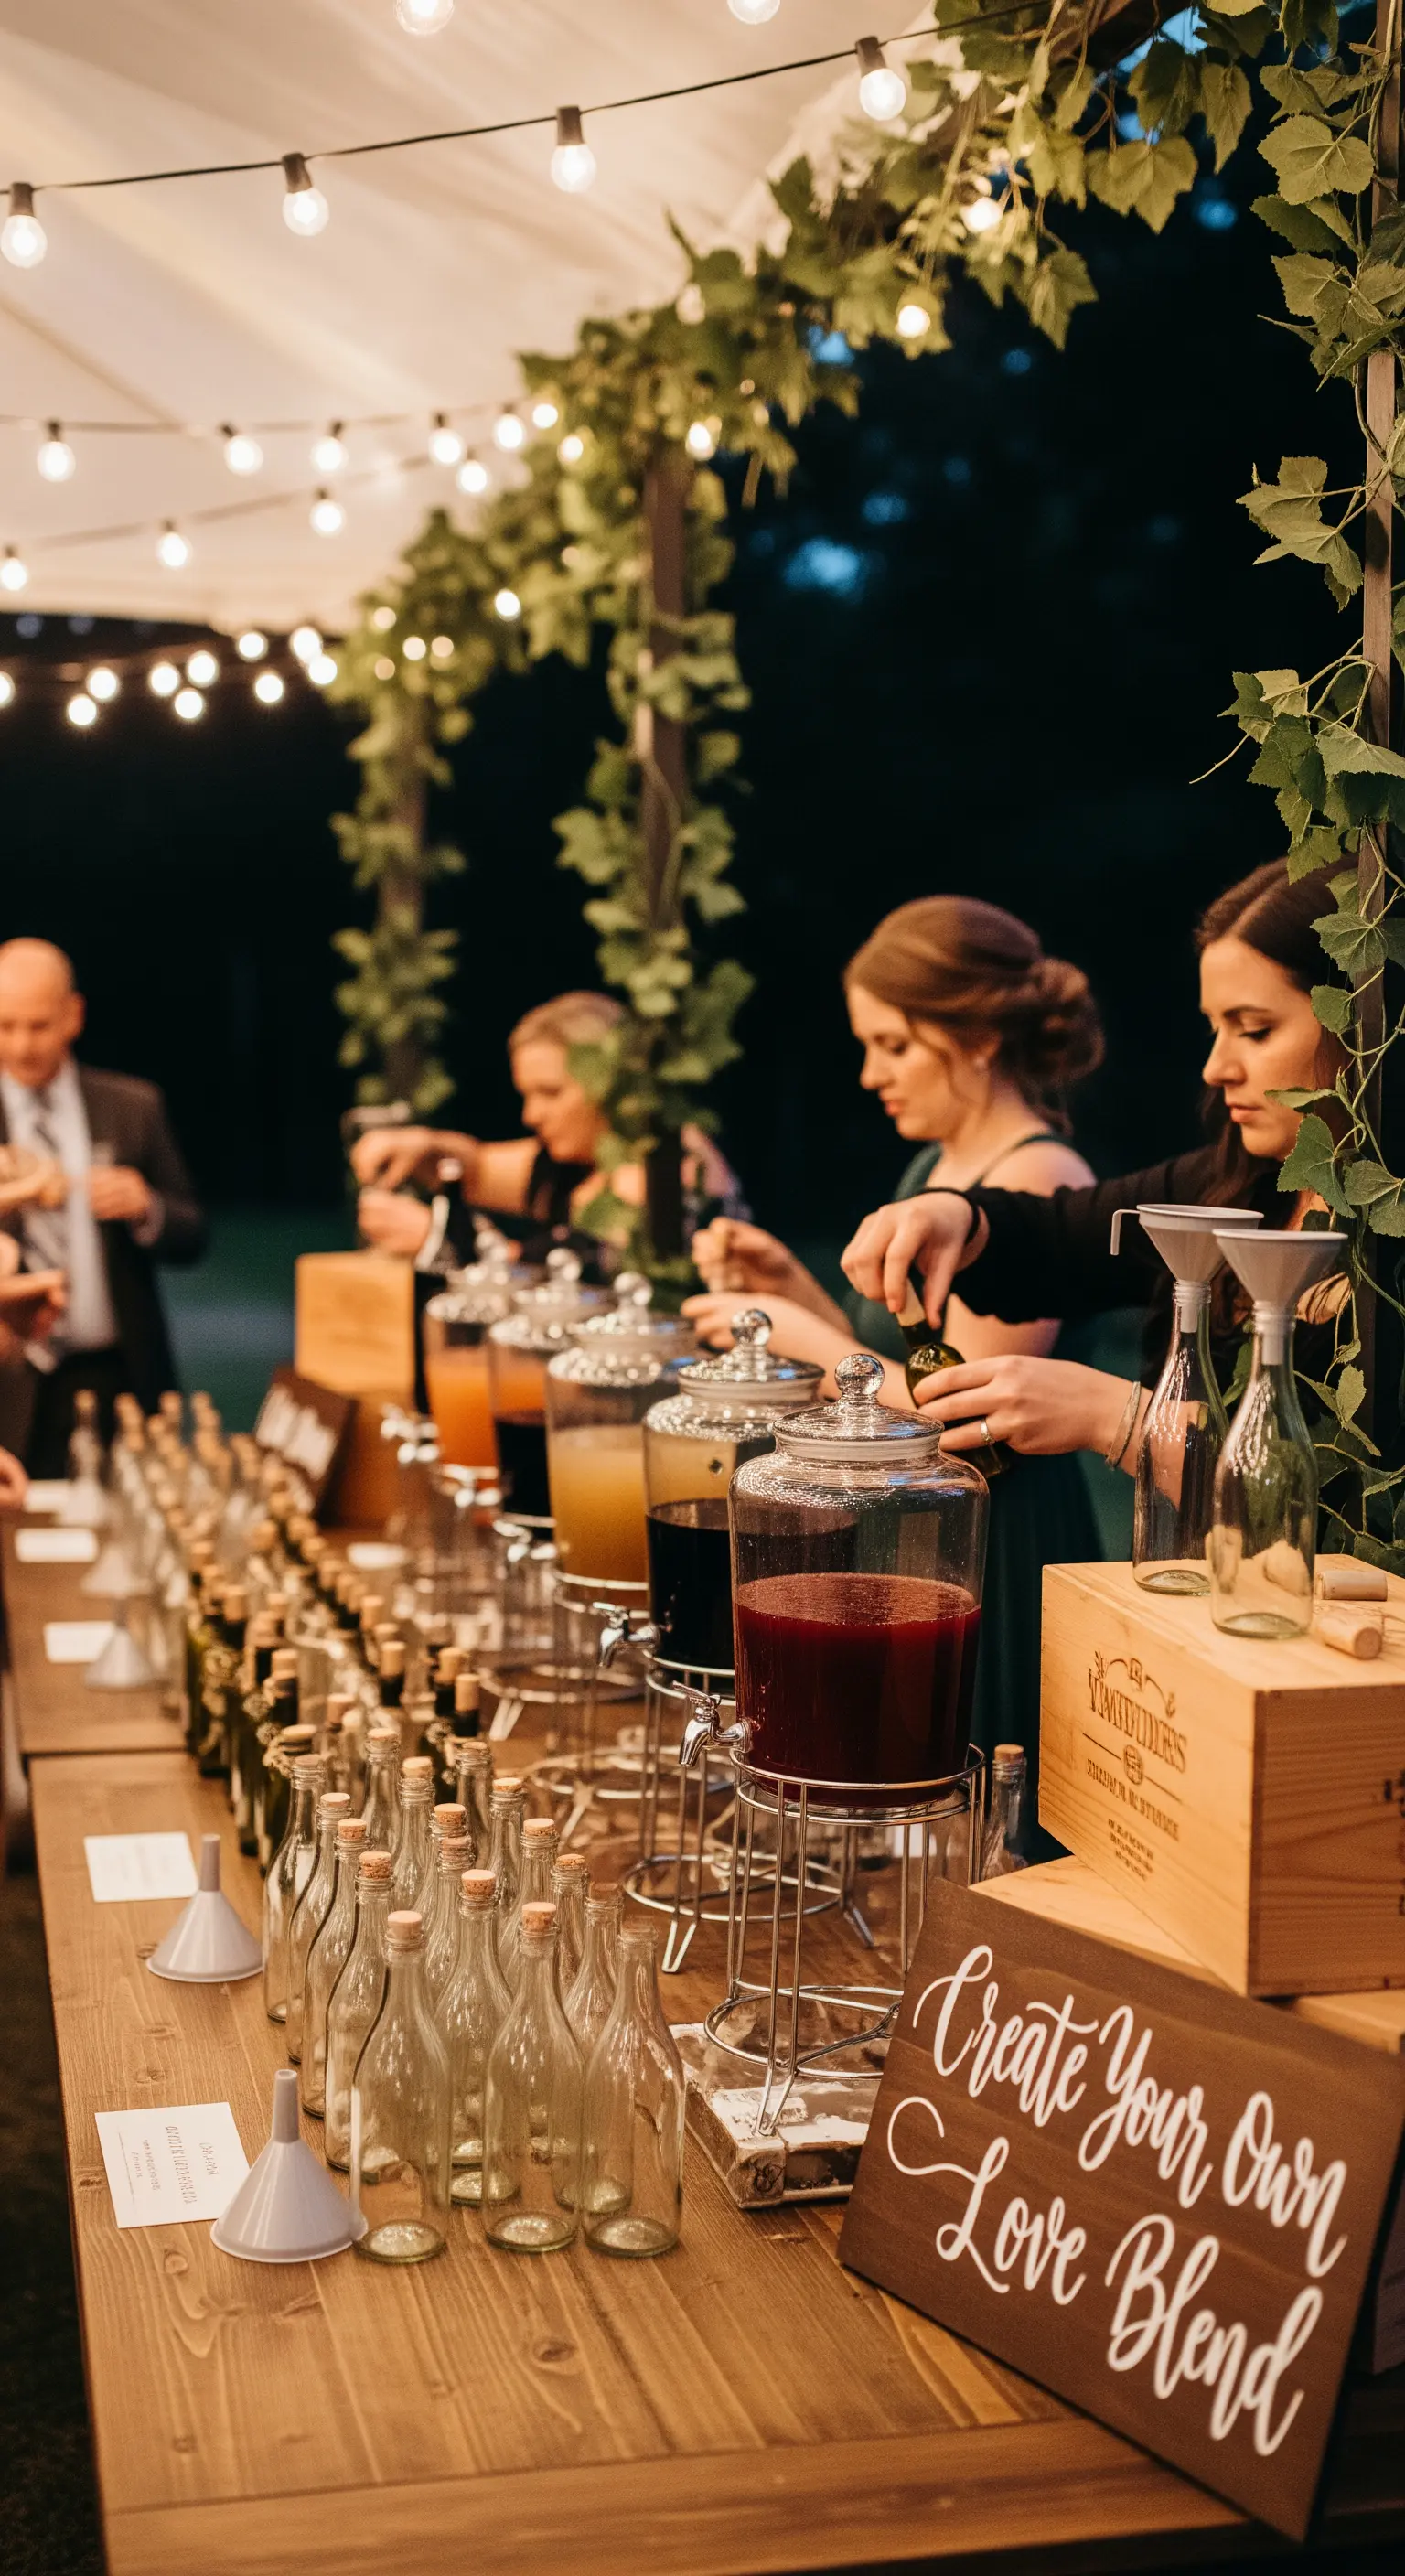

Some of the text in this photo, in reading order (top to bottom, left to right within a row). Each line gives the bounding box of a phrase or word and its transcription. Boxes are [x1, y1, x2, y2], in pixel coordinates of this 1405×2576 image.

[887, 2096, 1323, 2455] Love Blend
[912, 1944, 1347, 2278] Create Your Own
